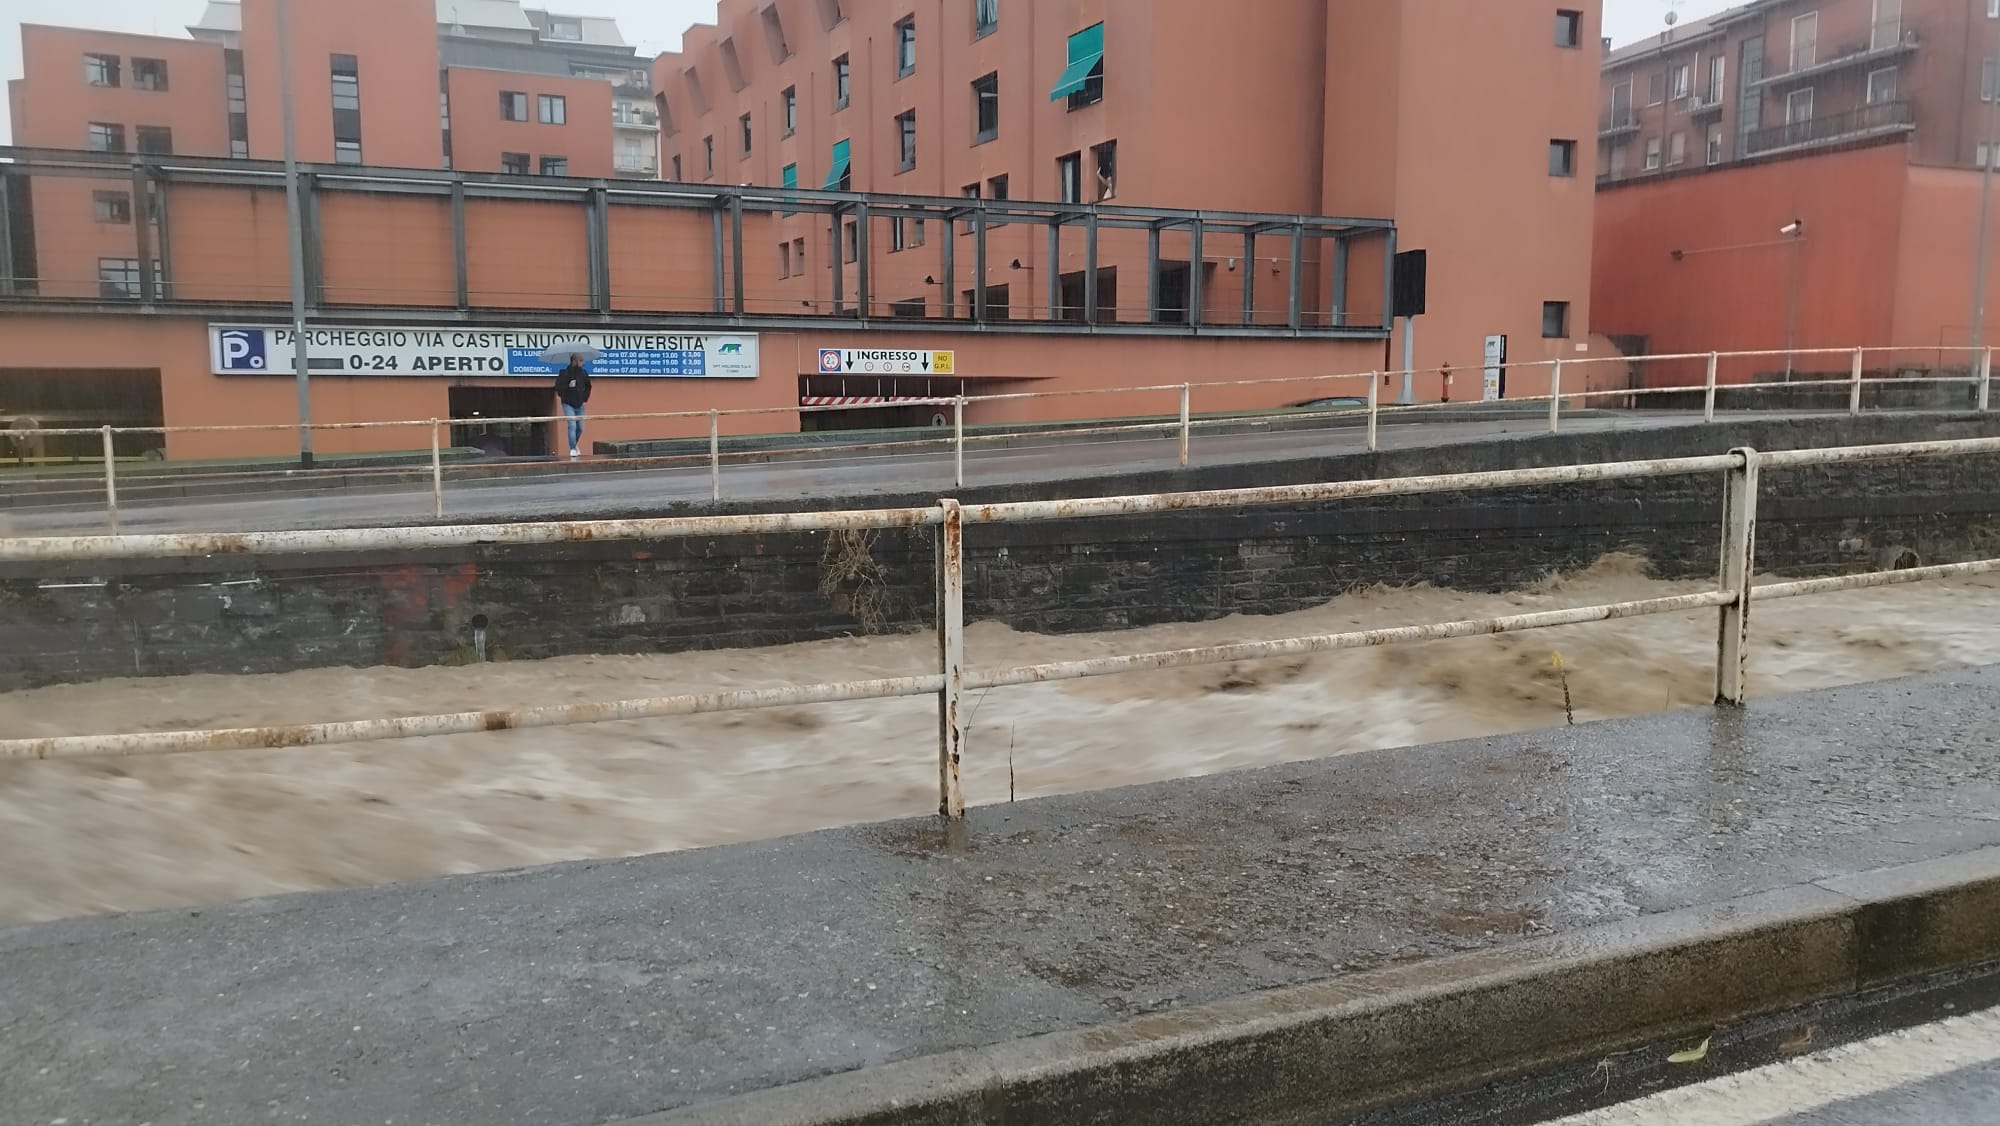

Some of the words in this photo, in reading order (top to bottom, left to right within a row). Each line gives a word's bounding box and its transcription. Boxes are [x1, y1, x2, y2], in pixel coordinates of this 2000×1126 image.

[274, 330, 407, 347] PARCHEGGIO
[413, 332, 445, 348] VIA
[349, 354, 399, 370] 0-24
[412, 355, 504, 371] APERTO
[857, 351, 918, 361] INGRESSO
